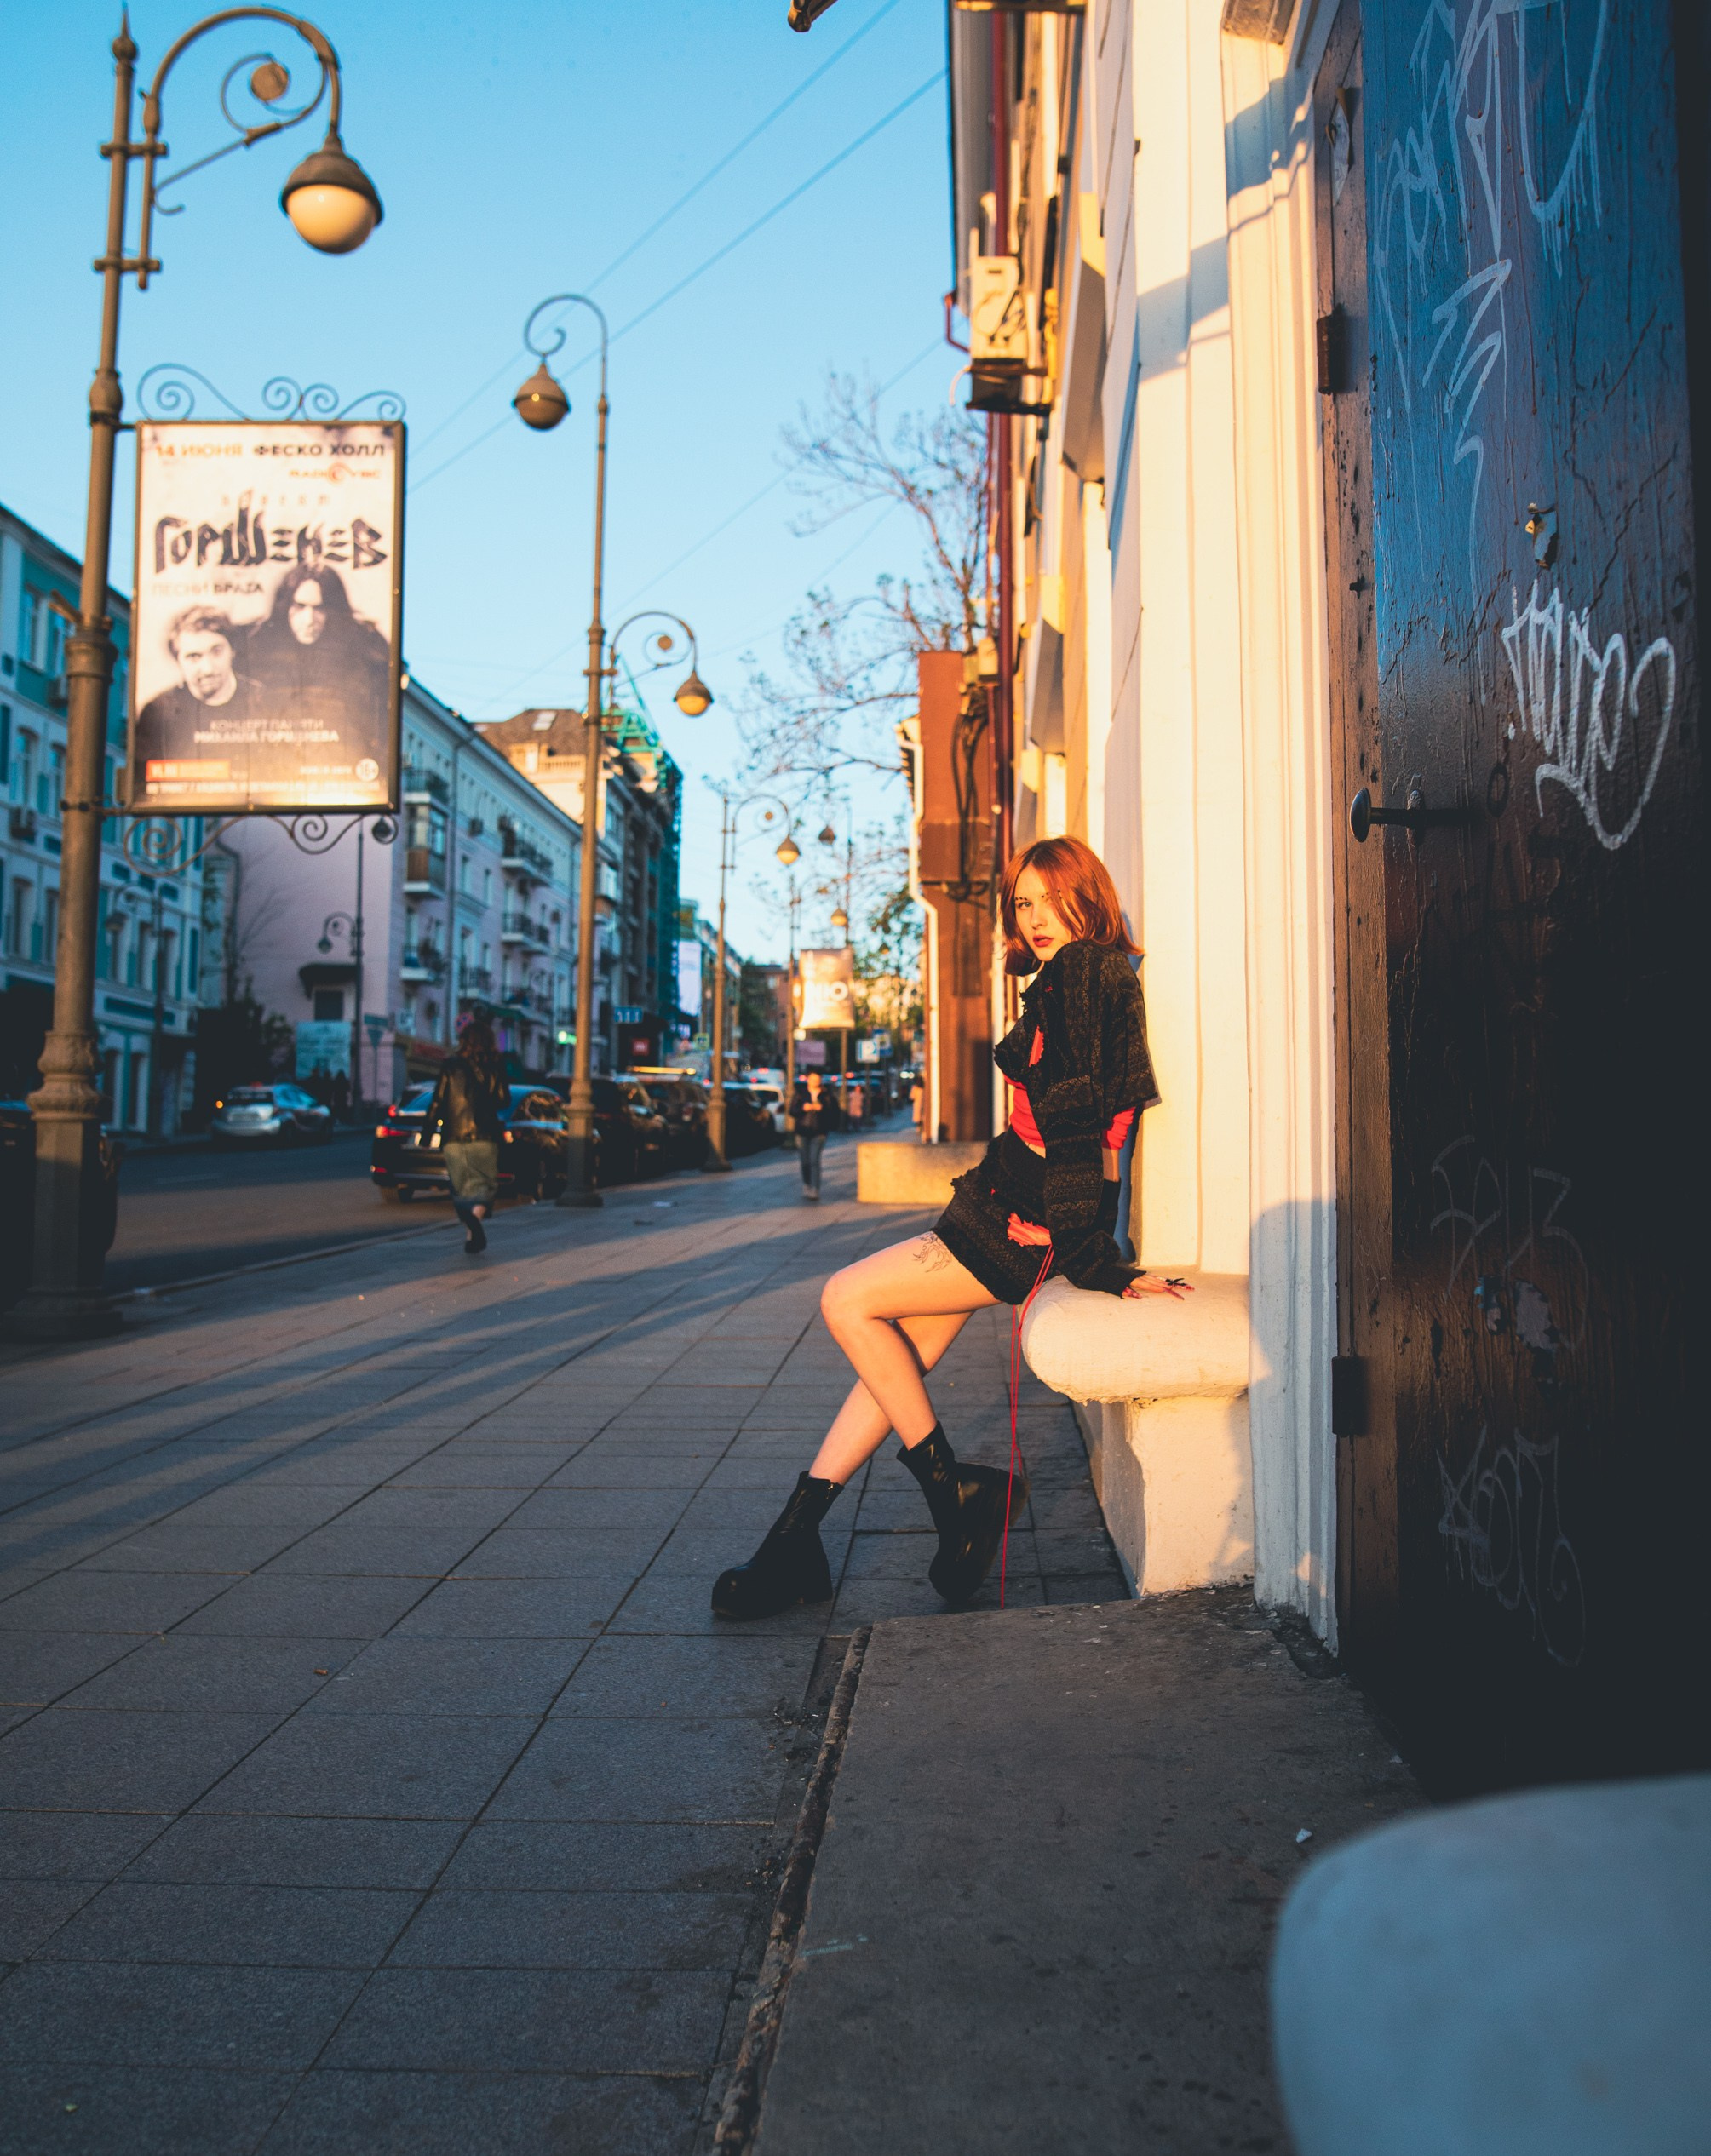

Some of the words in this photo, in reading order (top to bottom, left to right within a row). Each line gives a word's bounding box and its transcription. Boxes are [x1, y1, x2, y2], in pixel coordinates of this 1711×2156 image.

[156, 444, 175, 457] 14
[181, 444, 243, 457] ИЮНЯ
[253, 443, 322, 456] ФЕСКО
[330, 443, 385, 456] ХОЛЛ
[213, 582, 265, 595] БРАТА
